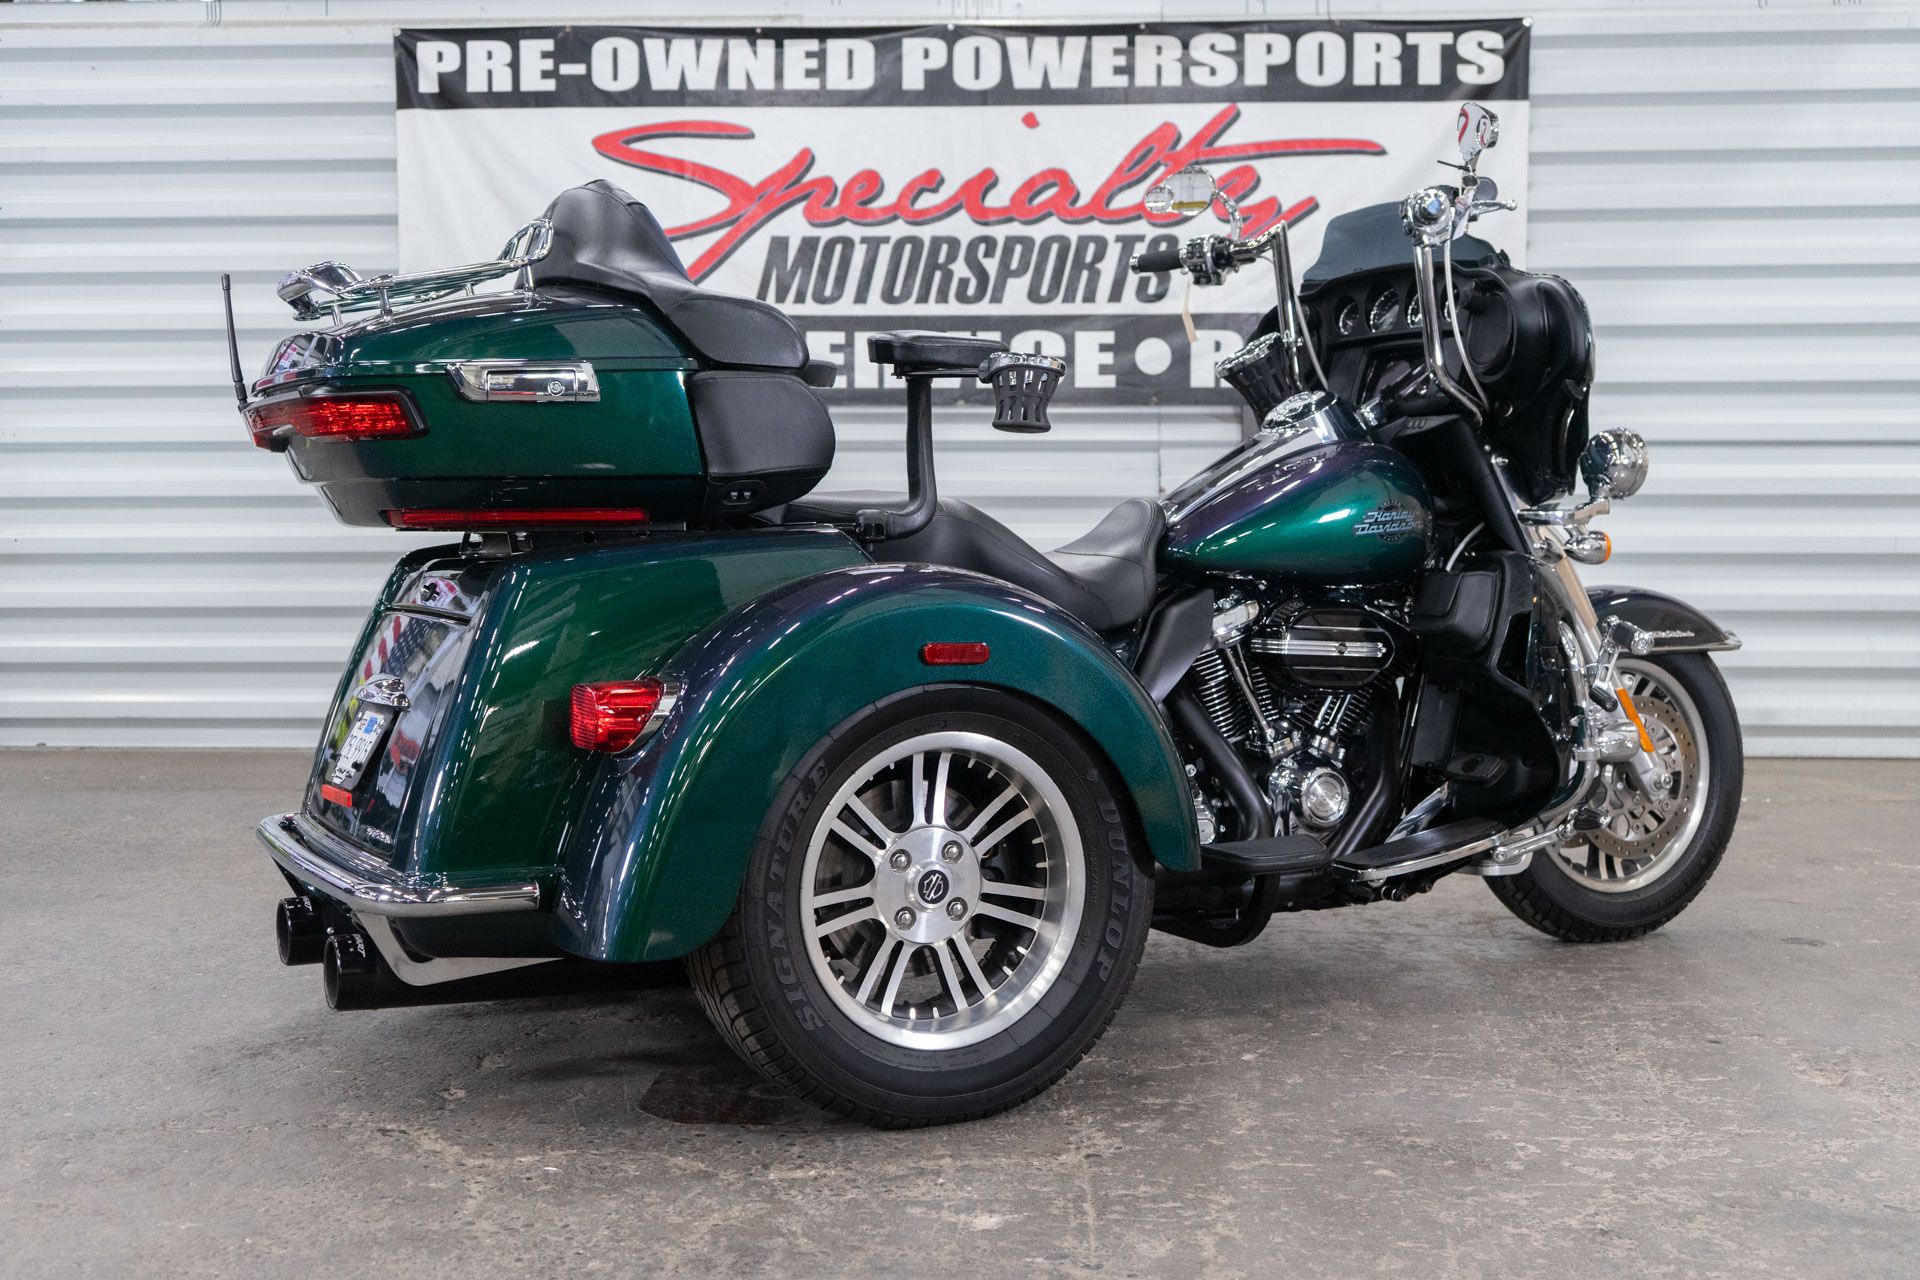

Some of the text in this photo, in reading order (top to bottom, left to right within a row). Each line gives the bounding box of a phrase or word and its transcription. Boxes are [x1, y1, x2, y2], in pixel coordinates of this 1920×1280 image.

[415, 30, 1505, 94] PRE-OWNED POWERSPORTS
[591, 102, 1388, 286] Specialty
[757, 232, 1185, 306] MOTORSPORTS
[1364, 508, 1416, 523] Harley
[765, 757, 828, 1032] SIGNATURE
[1095, 798, 1131, 985] DUNLOP
